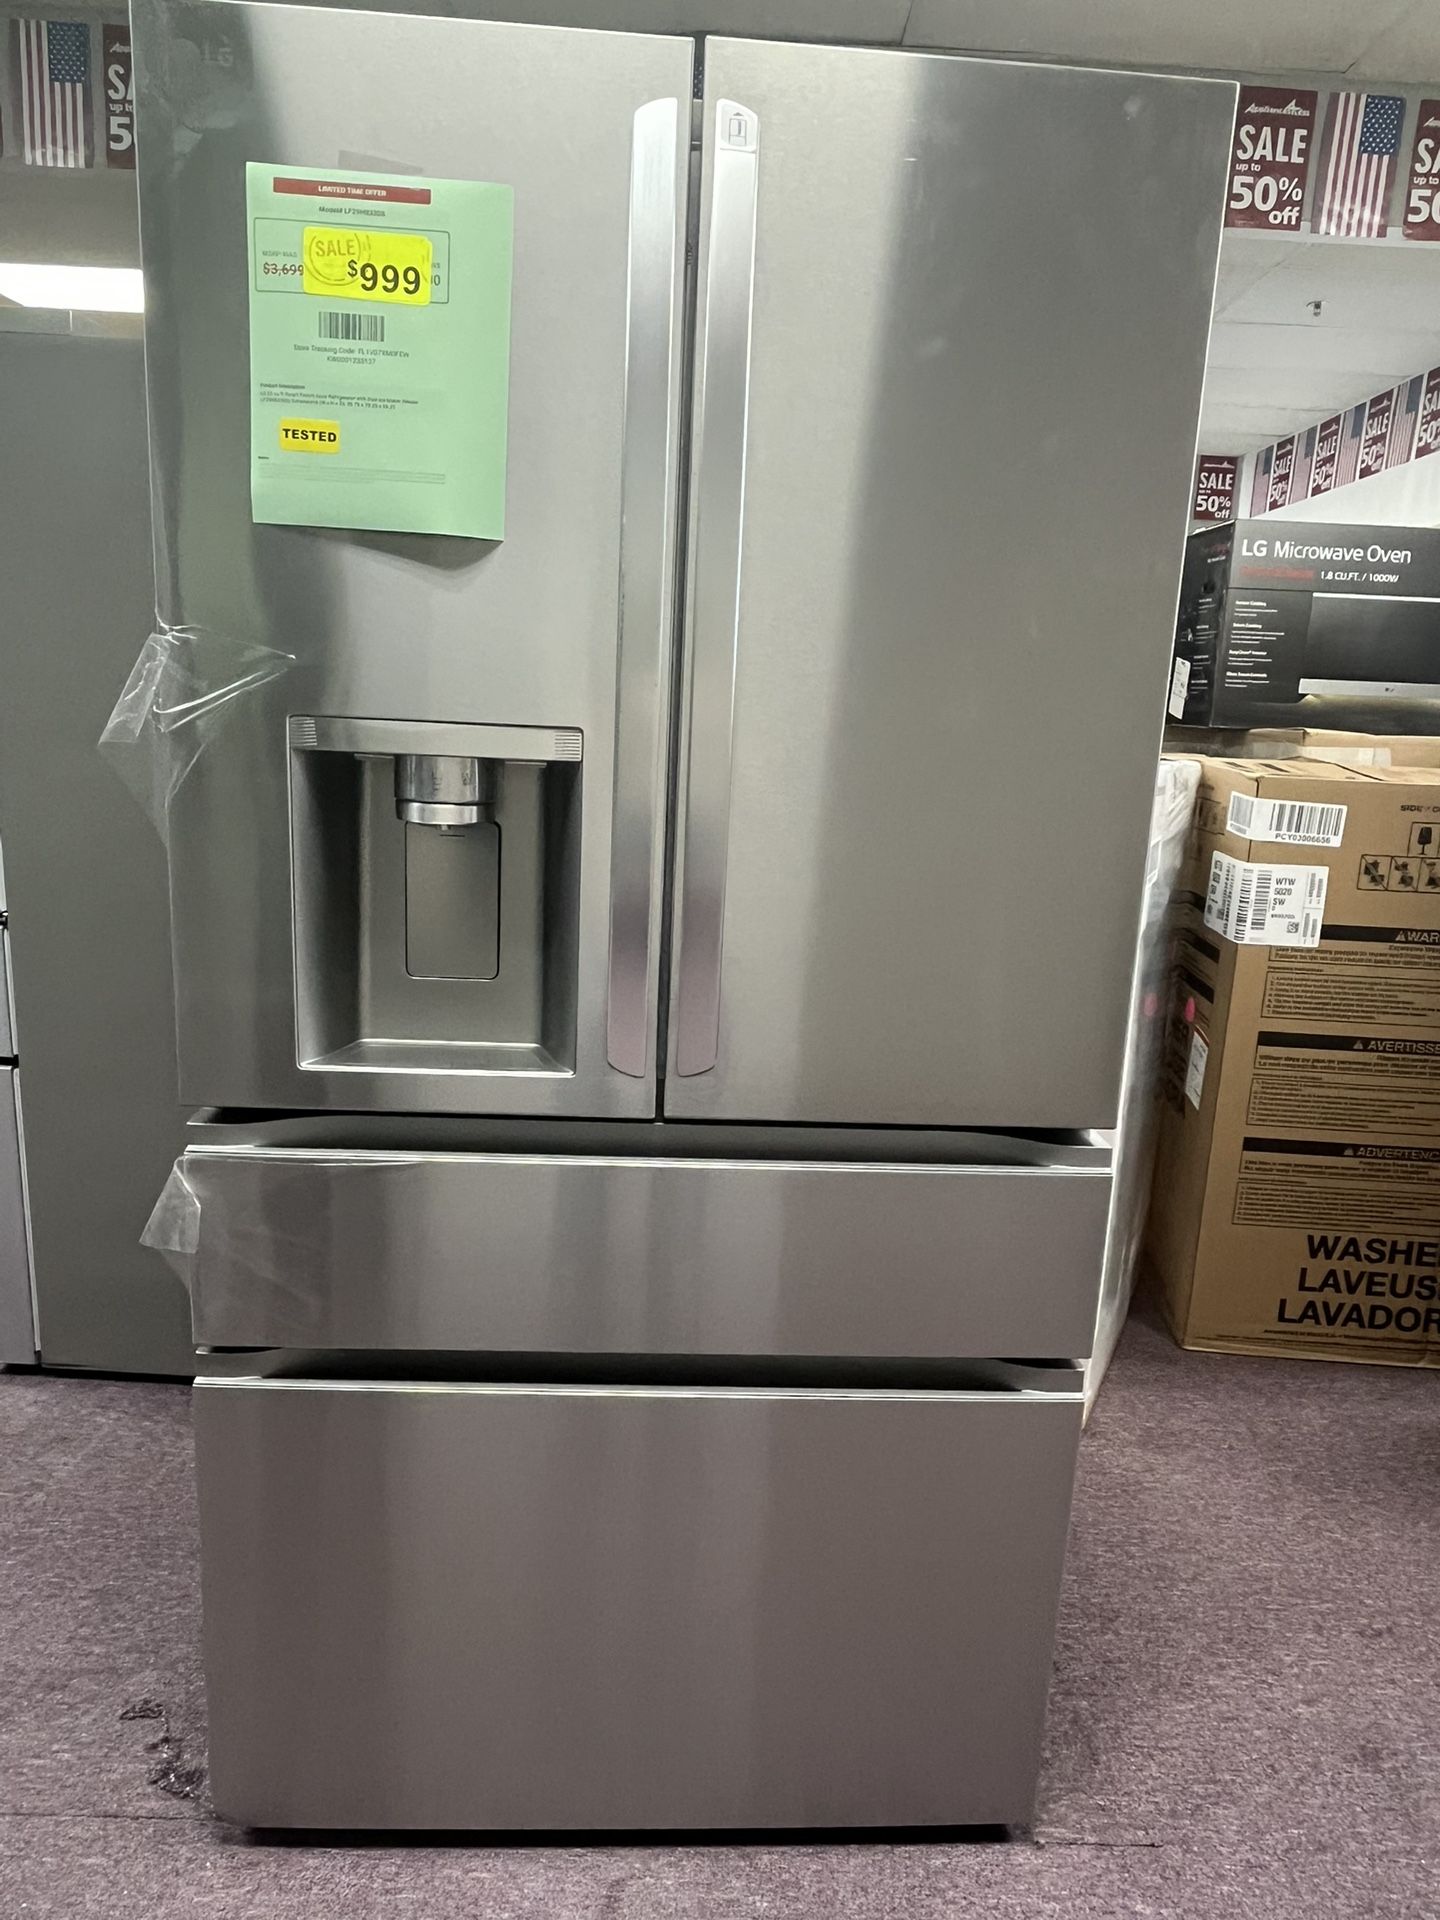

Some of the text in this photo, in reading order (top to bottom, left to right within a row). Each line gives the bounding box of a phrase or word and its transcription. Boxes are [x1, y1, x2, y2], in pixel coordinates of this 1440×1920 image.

[1236, 124, 1308, 164] SALE
[1235, 163, 1261, 172] up to
[1413, 176, 1440, 185] up to
[365, 188, 387, 198] OFFER
[1230, 175, 1303, 212] 50%
[1268, 206, 1300, 225] off
[315, 239, 356, 258] SALE
[347, 259, 421, 295] $999
[282, 428, 337, 442] TESTED
[1366, 412, 1390, 440] SALE
[1316, 436, 1338, 461] SALE
[1360, 441, 1385, 469] 50%
[1274, 455, 1292, 478] SALE
[1199, 472, 1234, 490] SALE
[1195, 495, 1232, 512] 50%
[1214, 509, 1231, 519] off
[1241, 539, 1412, 565] LG Microwave Oven
[1320, 571, 1333, 580] 1.8
[1369, 573, 1400, 583] 1000W
[1275, 877, 1297, 886] WTW
[1272, 897, 1286, 906] SW
